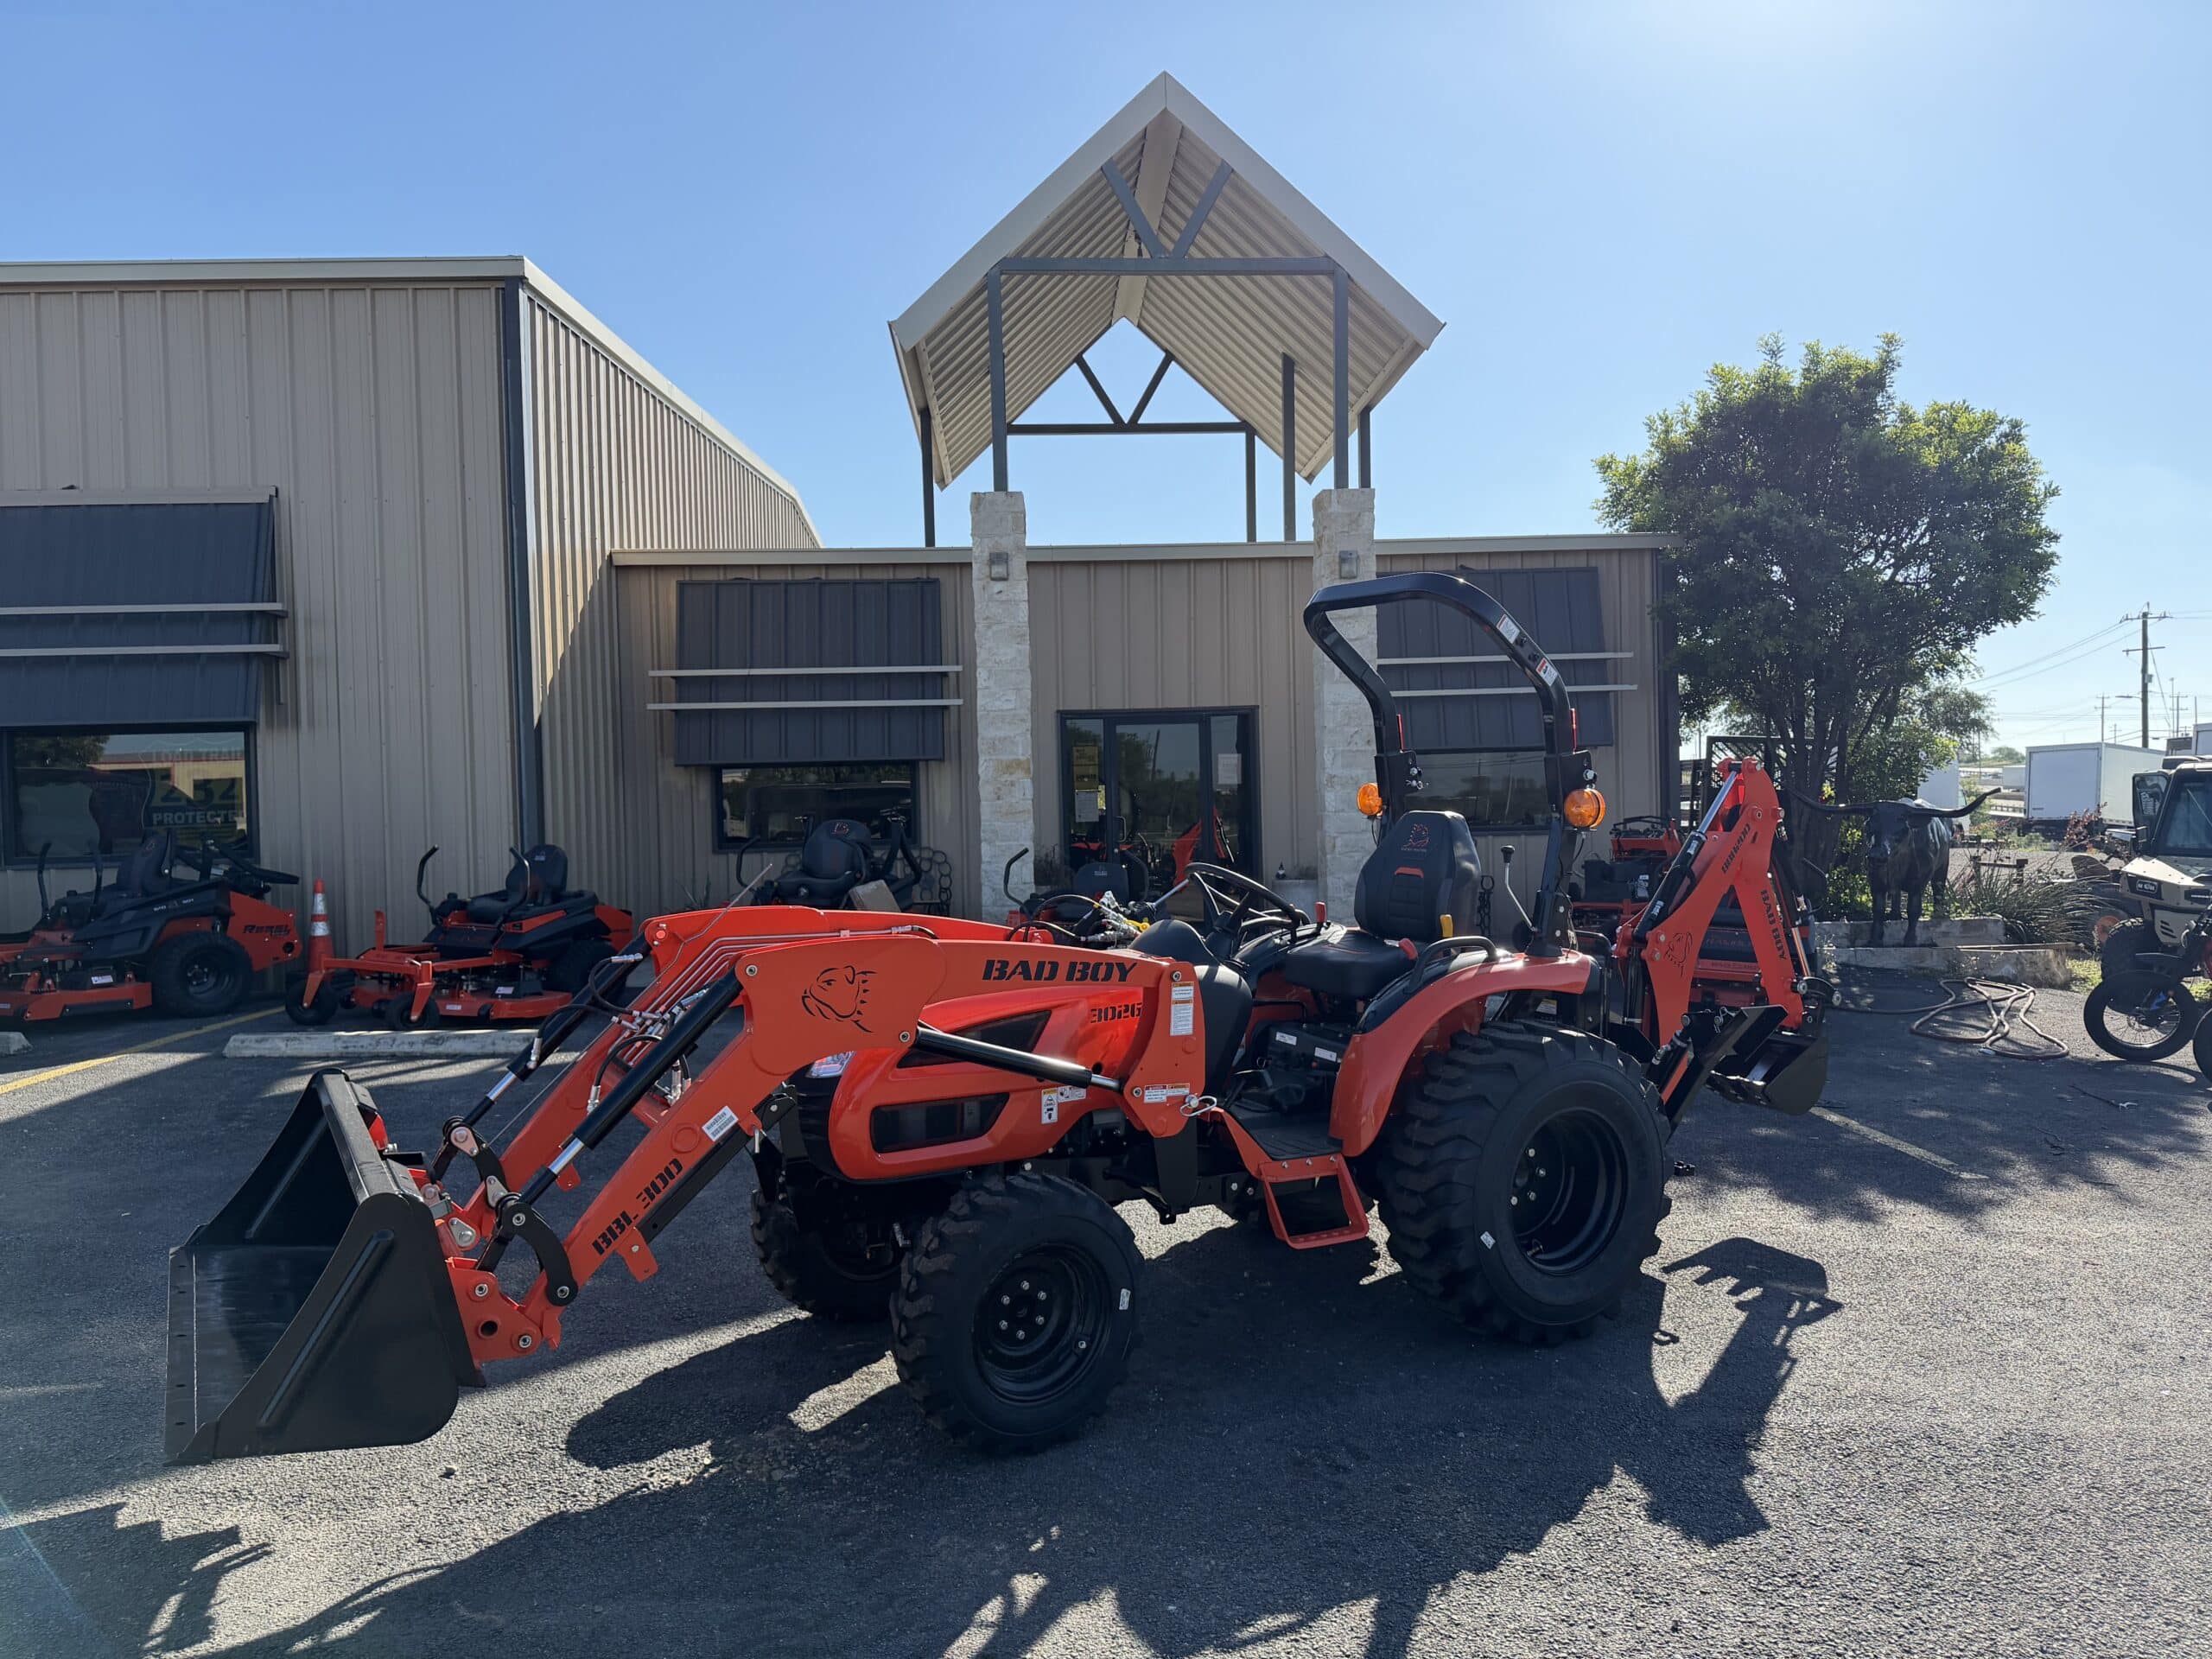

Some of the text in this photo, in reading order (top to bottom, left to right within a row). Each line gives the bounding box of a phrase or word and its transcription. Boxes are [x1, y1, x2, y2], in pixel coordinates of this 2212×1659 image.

[1760, 889, 1787, 959] BAD BOY
[982, 959, 1137, 982] BAD BOY
[1090, 1002, 1142, 1024] 3026
[592, 1158, 683, 1255] BBL 300
